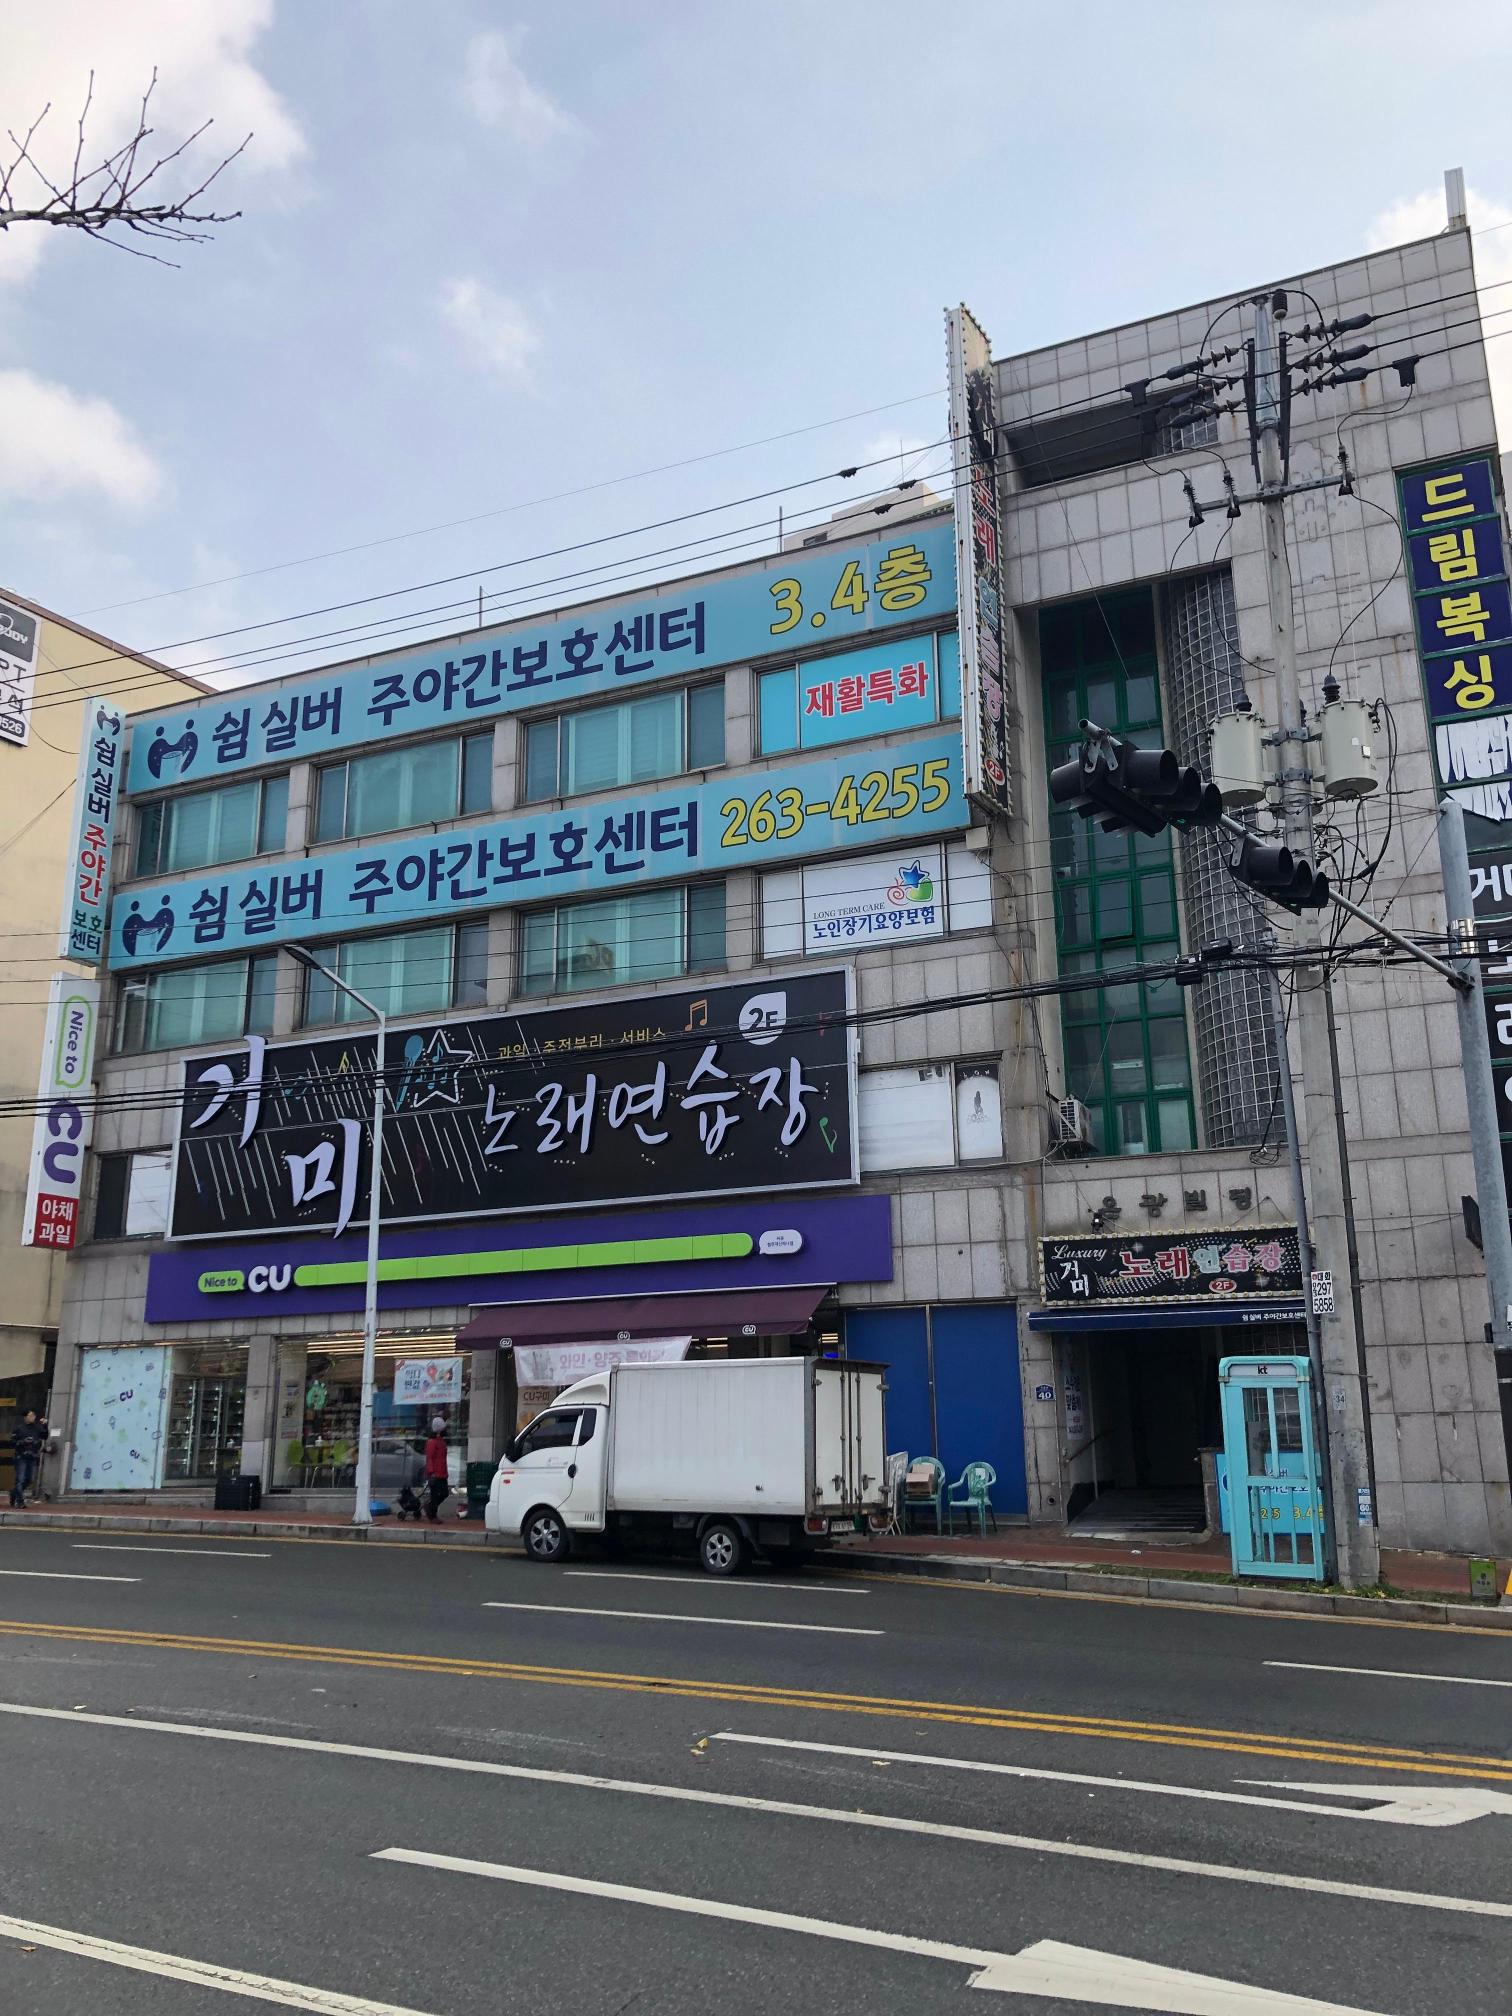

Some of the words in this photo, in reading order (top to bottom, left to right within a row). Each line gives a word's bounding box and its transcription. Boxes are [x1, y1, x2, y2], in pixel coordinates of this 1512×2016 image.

[1422, 473, 1495, 709] 드림복싱
[367, 601, 705, 727] 주야간보호센터
[769, 543, 933, 635] 3.4층
[804, 661, 929, 717] 재활특화
[719, 757, 950, 849] 263-4255
[79, 823, 107, 906] 주야간
[348, 801, 698, 914] 주야간보호센터
[73, 908, 103, 934] 보호
[812, 905, 935, 939] 노인장기요양보험
[813, 909, 836, 920] LONG
[838, 905, 861, 916] TERM
[862, 901, 885, 913] CARE
[71, 928, 100, 955] 센터
[67, 1010, 84, 1051] Nice
[748, 1007, 778, 1029] 2F
[620, 1027, 667, 1045] 서비스
[64, 1055, 78, 1074] to
[484, 1039, 819, 1157] 노래연습장
[43, 1099, 83, 1185] CU
[41, 1200, 74, 1222] 야채
[38, 1221, 71, 1244] 과일
[1051, 1244, 1108, 1261] Luxury
[1119, 1242, 1286, 1280] 노래연습장
[204, 1277, 225, 1288] Nice
[227, 1277, 238, 1287] to
[248, 1264, 292, 1293] CU
[1060, 1260, 1090, 1297] 거미
[1215, 1281, 1231, 1290] 2F
[1317, 1282, 1332, 1296] 297
[1313, 1297, 1333, 1312] 5858
[1257, 1365, 1268, 1375] kt
[120, 1389, 133, 1401] CU
[1038, 1392, 1052, 1400] 40
[129, 1449, 140, 1459] CU
